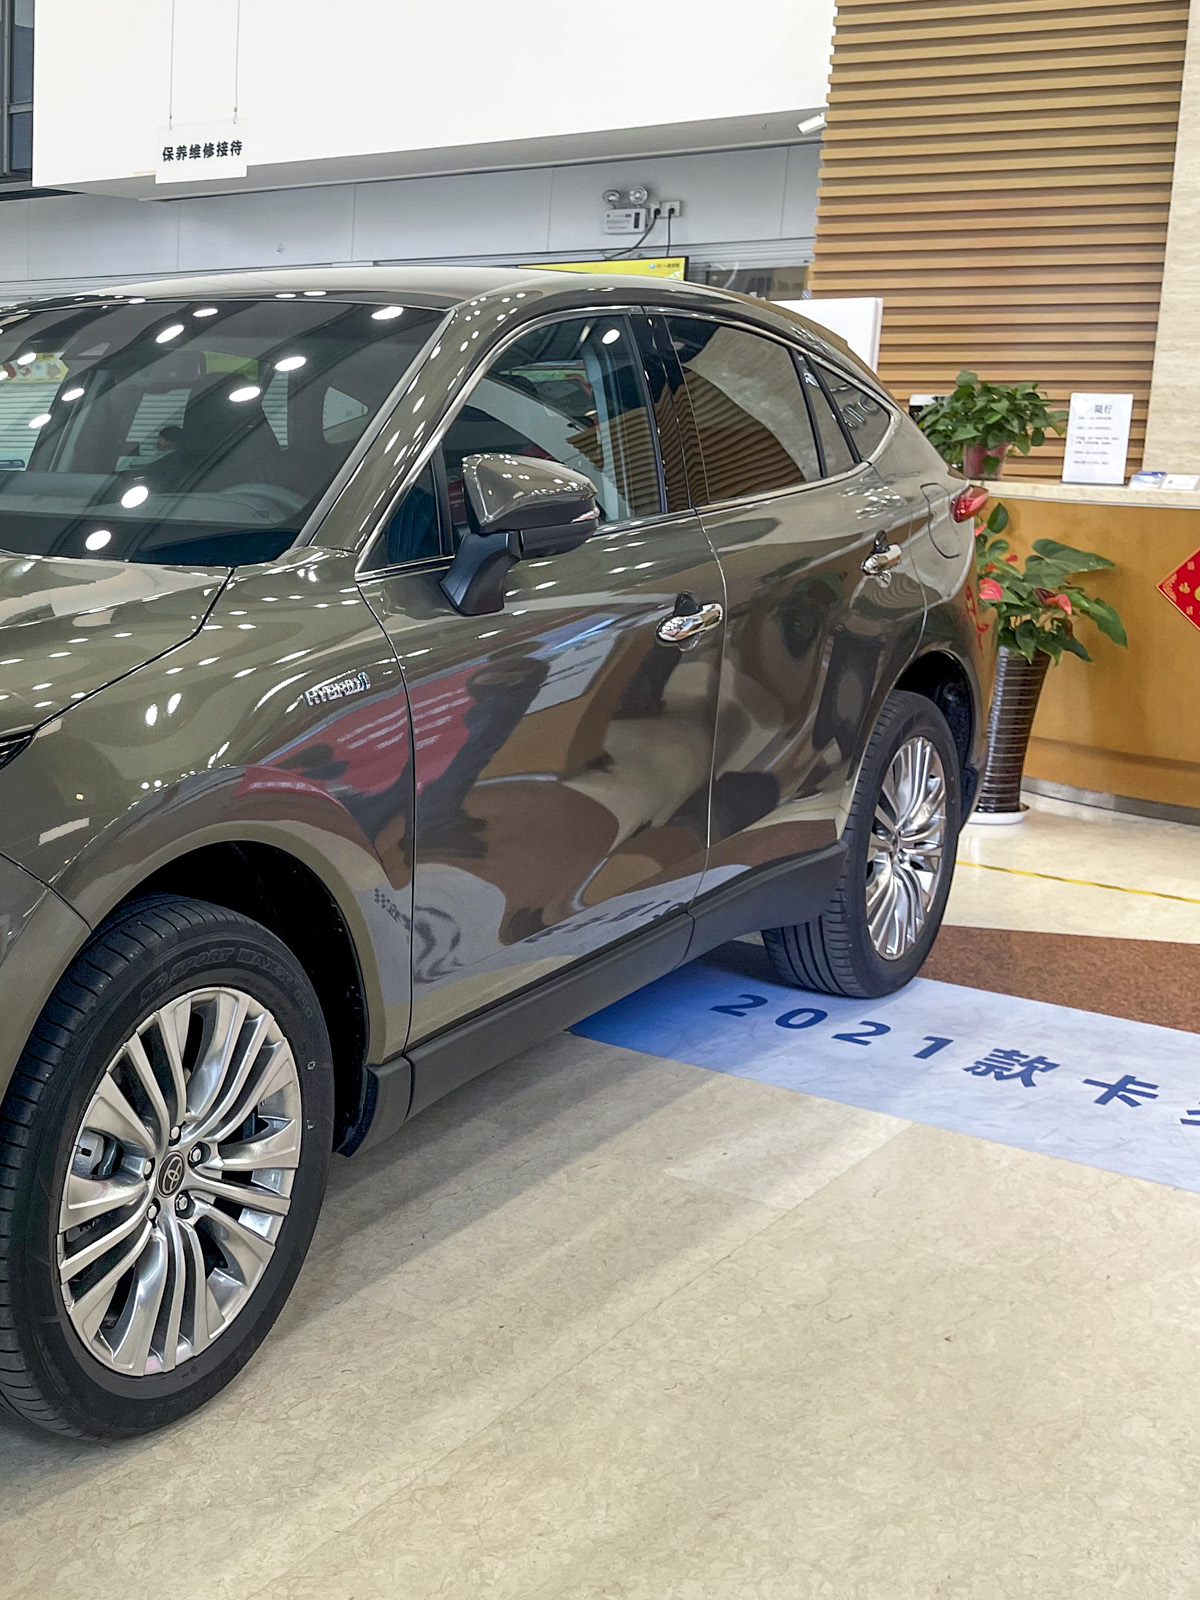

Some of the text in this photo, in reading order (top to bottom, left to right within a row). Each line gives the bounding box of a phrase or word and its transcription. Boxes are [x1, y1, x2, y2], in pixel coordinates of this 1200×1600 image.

[162, 140, 242, 162] 保养维修接待
[303, 676, 367, 706] HYBRID
